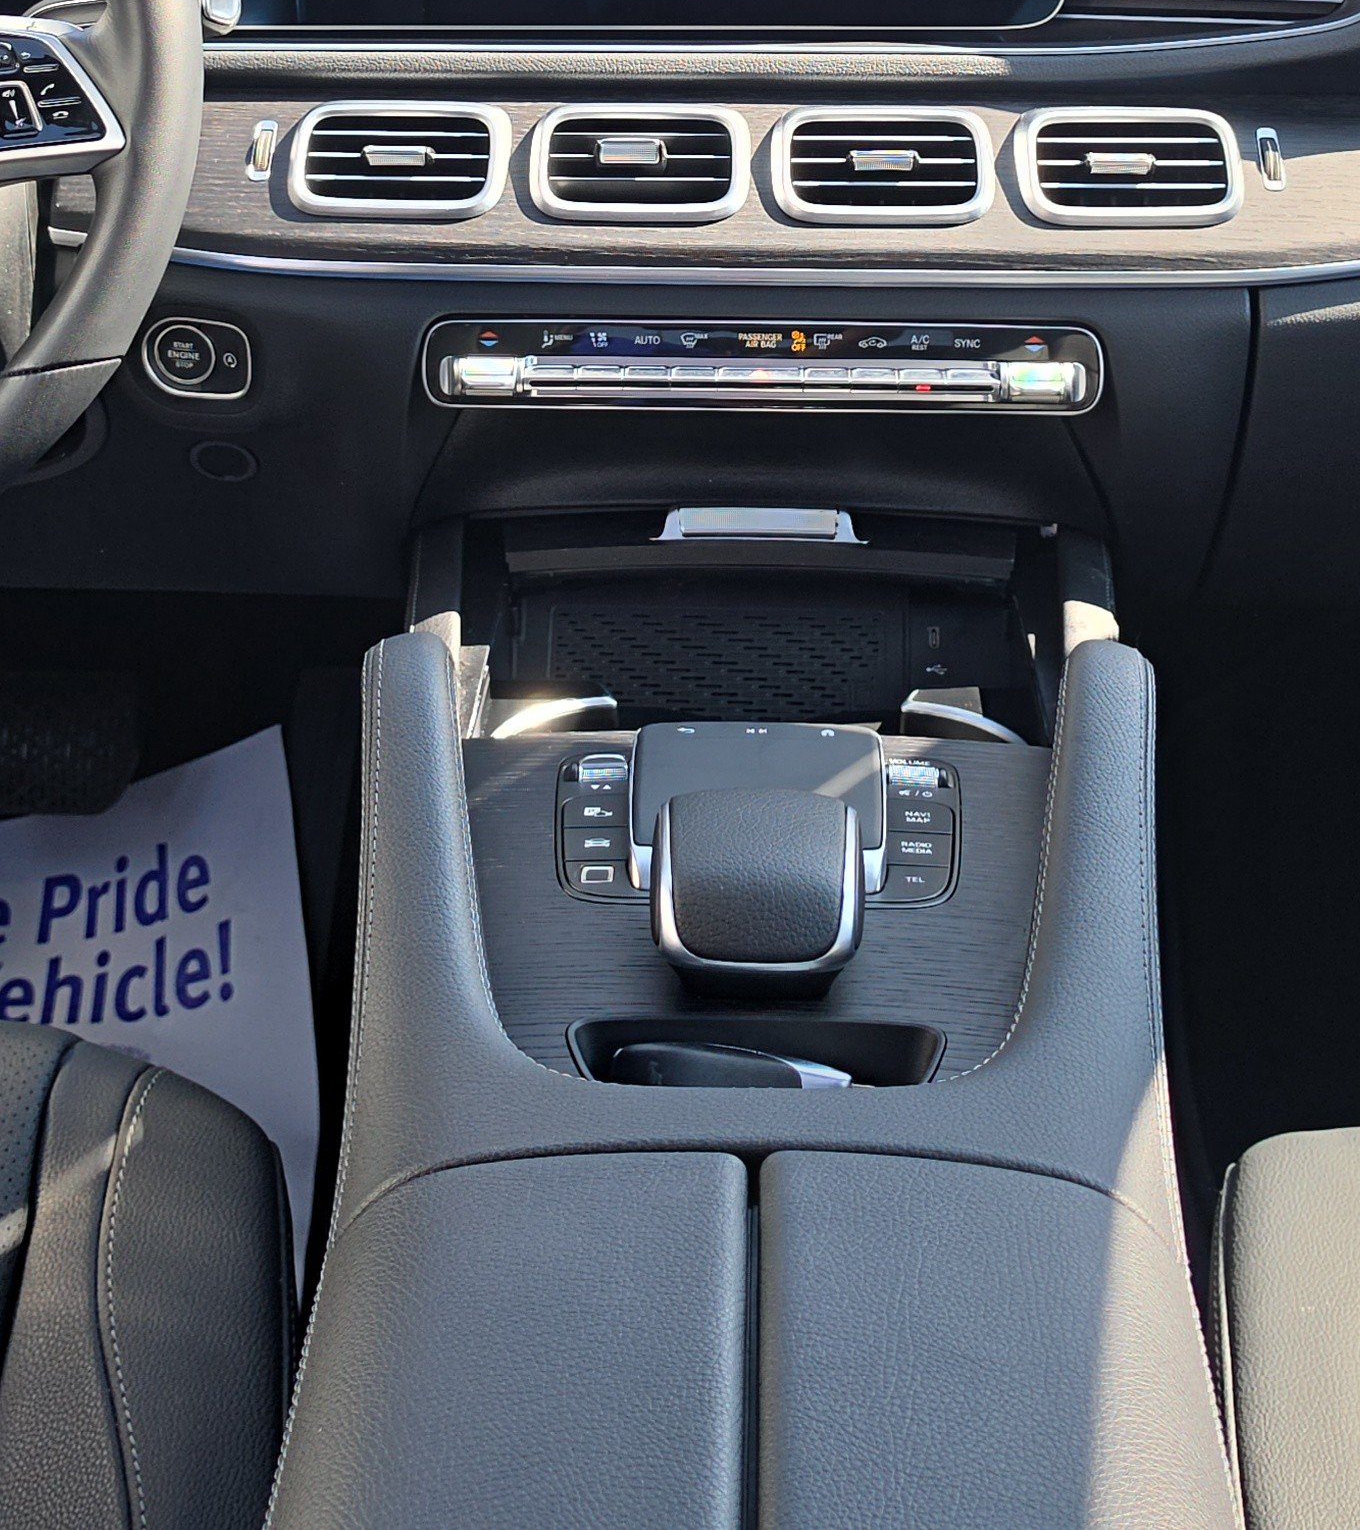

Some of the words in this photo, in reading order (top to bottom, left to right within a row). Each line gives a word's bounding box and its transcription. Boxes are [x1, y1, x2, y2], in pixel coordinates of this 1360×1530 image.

[634, 335, 661, 345] AUTO
[738, 333, 783, 342] PASSENGER
[910, 335, 930, 344] A/C
[172, 341, 194, 350] START
[745, 340, 759, 349] AIR
[760, 340, 777, 349] BAG
[954, 338, 981, 348] SYNC
[167, 350, 200, 360] ENGINE
[889, 758, 931, 766] VOLUME
[36, 842, 211, 946] Pride
